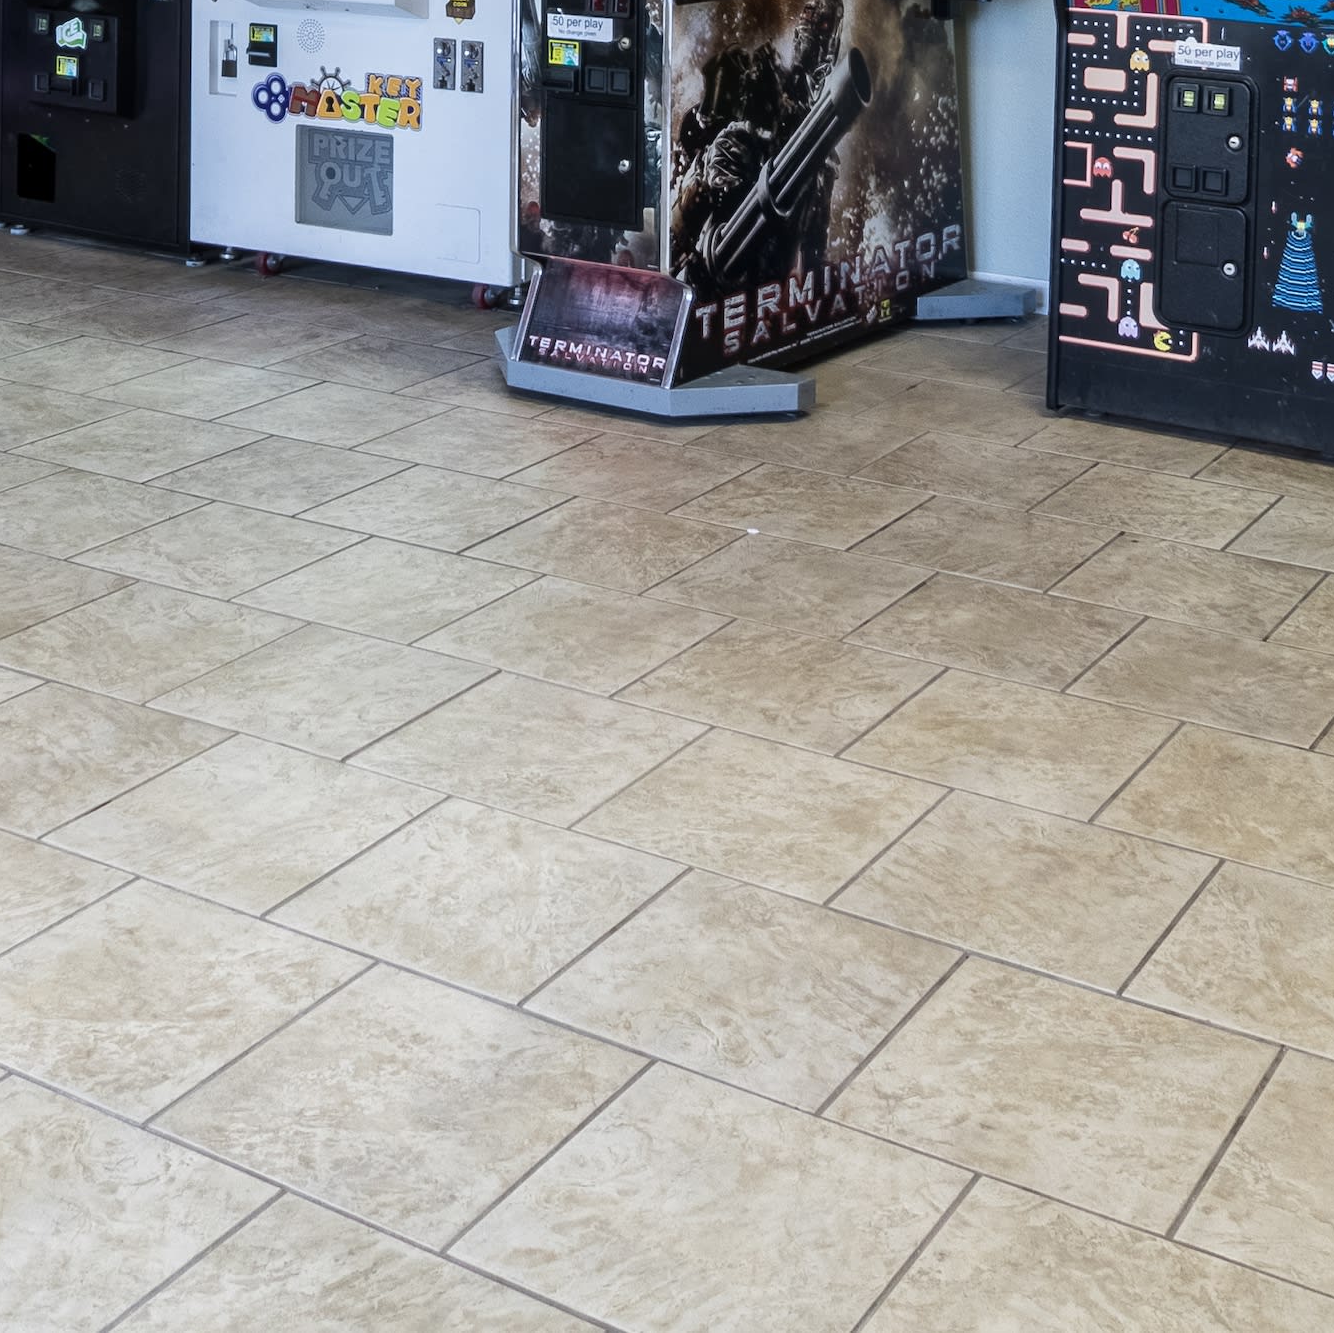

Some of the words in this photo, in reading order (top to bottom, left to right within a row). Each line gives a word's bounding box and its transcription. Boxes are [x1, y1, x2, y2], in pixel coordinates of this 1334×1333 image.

[58, 19, 81, 43] ICE
[552, 15, 564, 26] 50
[567, 18, 582, 27] per
[584, 18, 604, 31] play
[1177, 45, 1192, 56] 50
[1194, 48, 1213, 58] per
[1216, 48, 1240, 60] play
[369, 74, 421, 98] KEY
[289, 85, 422, 130] MASTER
[314, 133, 392, 165] PRIZE
[696, 223, 962, 339] TERMINATOR
[723, 261, 936, 356] SALVATION
[529, 335, 667, 370] TERMINATOR
[538, 347, 649, 374] SALVATION
